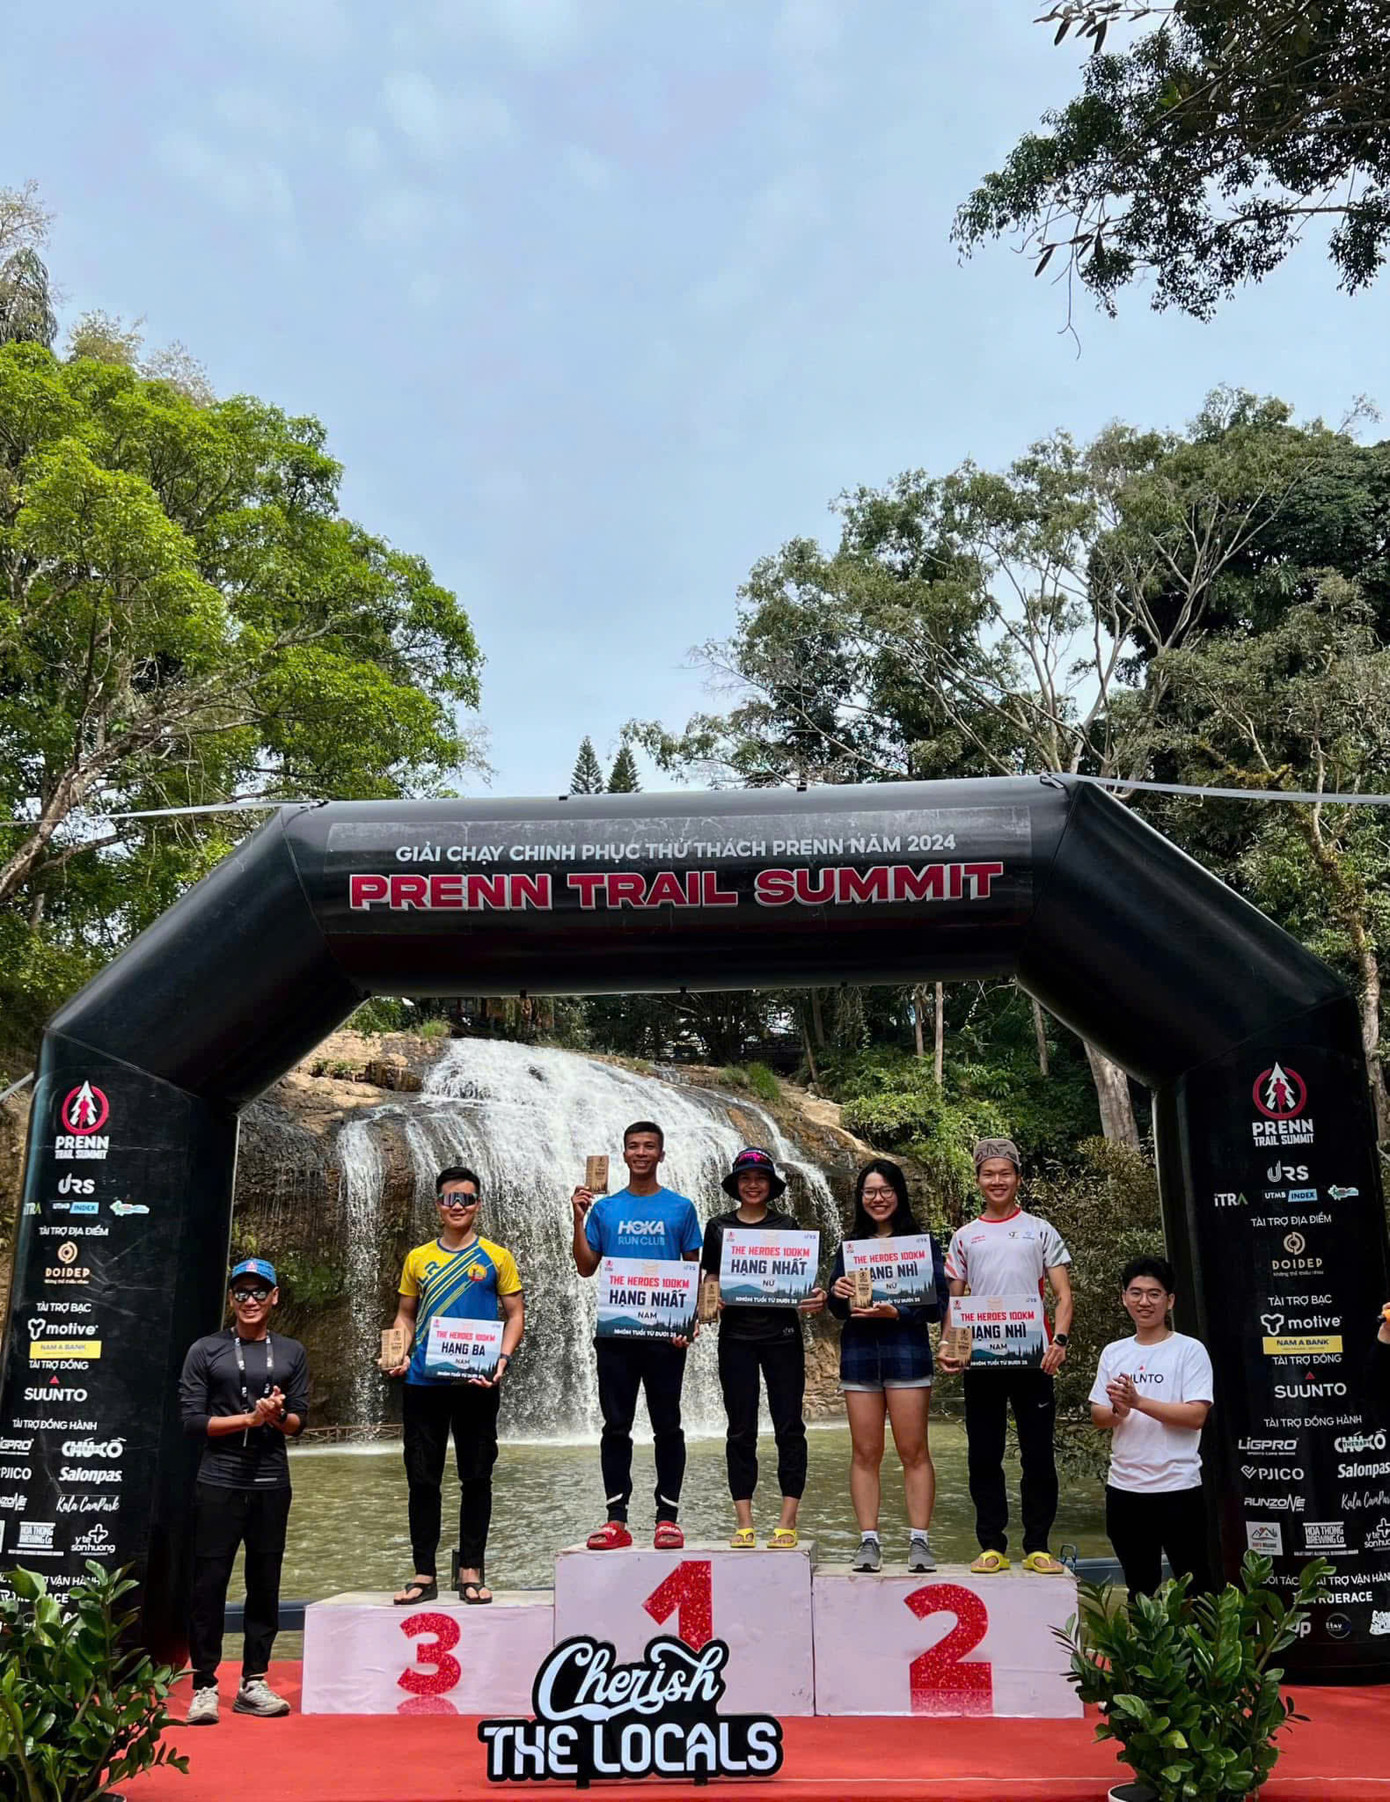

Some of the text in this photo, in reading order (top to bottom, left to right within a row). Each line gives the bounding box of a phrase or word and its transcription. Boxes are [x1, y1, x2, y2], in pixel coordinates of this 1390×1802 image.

[396, 841, 441, 862] GIẢI
[447, 846, 504, 865] CHẠY
[509, 844, 576, 861] CHINH
[582, 843, 640, 863] PHỤC
[693, 836, 766, 858] THÁCH
[773, 838, 844, 856] PRENN
[850, 834, 901, 854] NĂM
[907, 833, 957, 852] 2024
[349, 861, 1004, 911] PRENN TRAIL SUMMIT
[1252, 1118, 1314, 1137] PRENN
[55, 1135, 110, 1150] PRENN
[1253, 1132, 1314, 1148] TRAIL SUMMIT
[1291, 1192, 1315, 1200] INDEX
[618, 1220, 665, 1235] HOKA
[1251, 1216, 1266, 1227] TÀI
[1267, 1216, 1289, 1227] TRỢ
[1291, 1216, 1308, 1227] ĐỊA
[50, 1226, 67, 1236] TRỢ
[618, 1236, 665, 1246] RUN CLUB
[731, 1246, 810, 1257] THE HEROES 100KM
[853, 1250, 925, 1264] THE HEROES 100KM
[731, 1258, 807, 1276] HẠNG NHẤT
[897, 1261, 918, 1278] NHÌ
[1272, 1258, 1323, 1270] DOIDEP
[45, 1267, 90, 1278] DOIDEP
[610, 1275, 690, 1288] THE HEROES 100KM
[609, 1289, 687, 1308] HẠNG NHẤT
[1268, 1294, 1332, 1306] TÀI TRỢ BẠC
[50, 1302, 70, 1314] TRỢ
[70, 1303, 92, 1314] BẠC
[961, 1311, 1035, 1321] THE HEROES 100KM
[1288, 1315, 1340, 1329] motive
[46, 1322, 96, 1336] motive
[450, 1331, 473, 1340] HEROES
[1006, 1322, 1026, 1338] NHÌ
[441, 1341, 485, 1356] HẠNG BA
[41, 1360, 59, 1370] TRỢ
[1272, 1355, 1288, 1365] TÀI
[1289, 1355, 1310, 1366] TRỢ
[24, 1387, 88, 1402] SUUNTO
[1274, 1383, 1347, 1398] SUUNTO
[23, 1420, 40, 1430] TRỢ
[69, 1419, 98, 1430] HÀNH
[1264, 1417, 1279, 1427] TÀI
[1280, 1418, 1301, 1429] TRỢ
[1336, 1414, 1362, 1425] HÀNH
[0, 1467, 32, 1480] PJICO
[58, 1467, 122, 1484] Salonpas
[1259, 1468, 1304, 1480] PJICO
[1338, 1462, 1390, 1478] Salonpas
[50, 1574, 70, 1587] VẬN
[1327, 1576, 1349, 1587] TRỢ
[1351, 1573, 1370, 1586] VẬN
[642, 1560, 713, 1653] 1
[904, 1584, 992, 1690] 2
[396, 1612, 461, 1695] 3
[538, 1640, 726, 1721] Cherish
[484, 1722, 779, 1774] THE LOCALS
